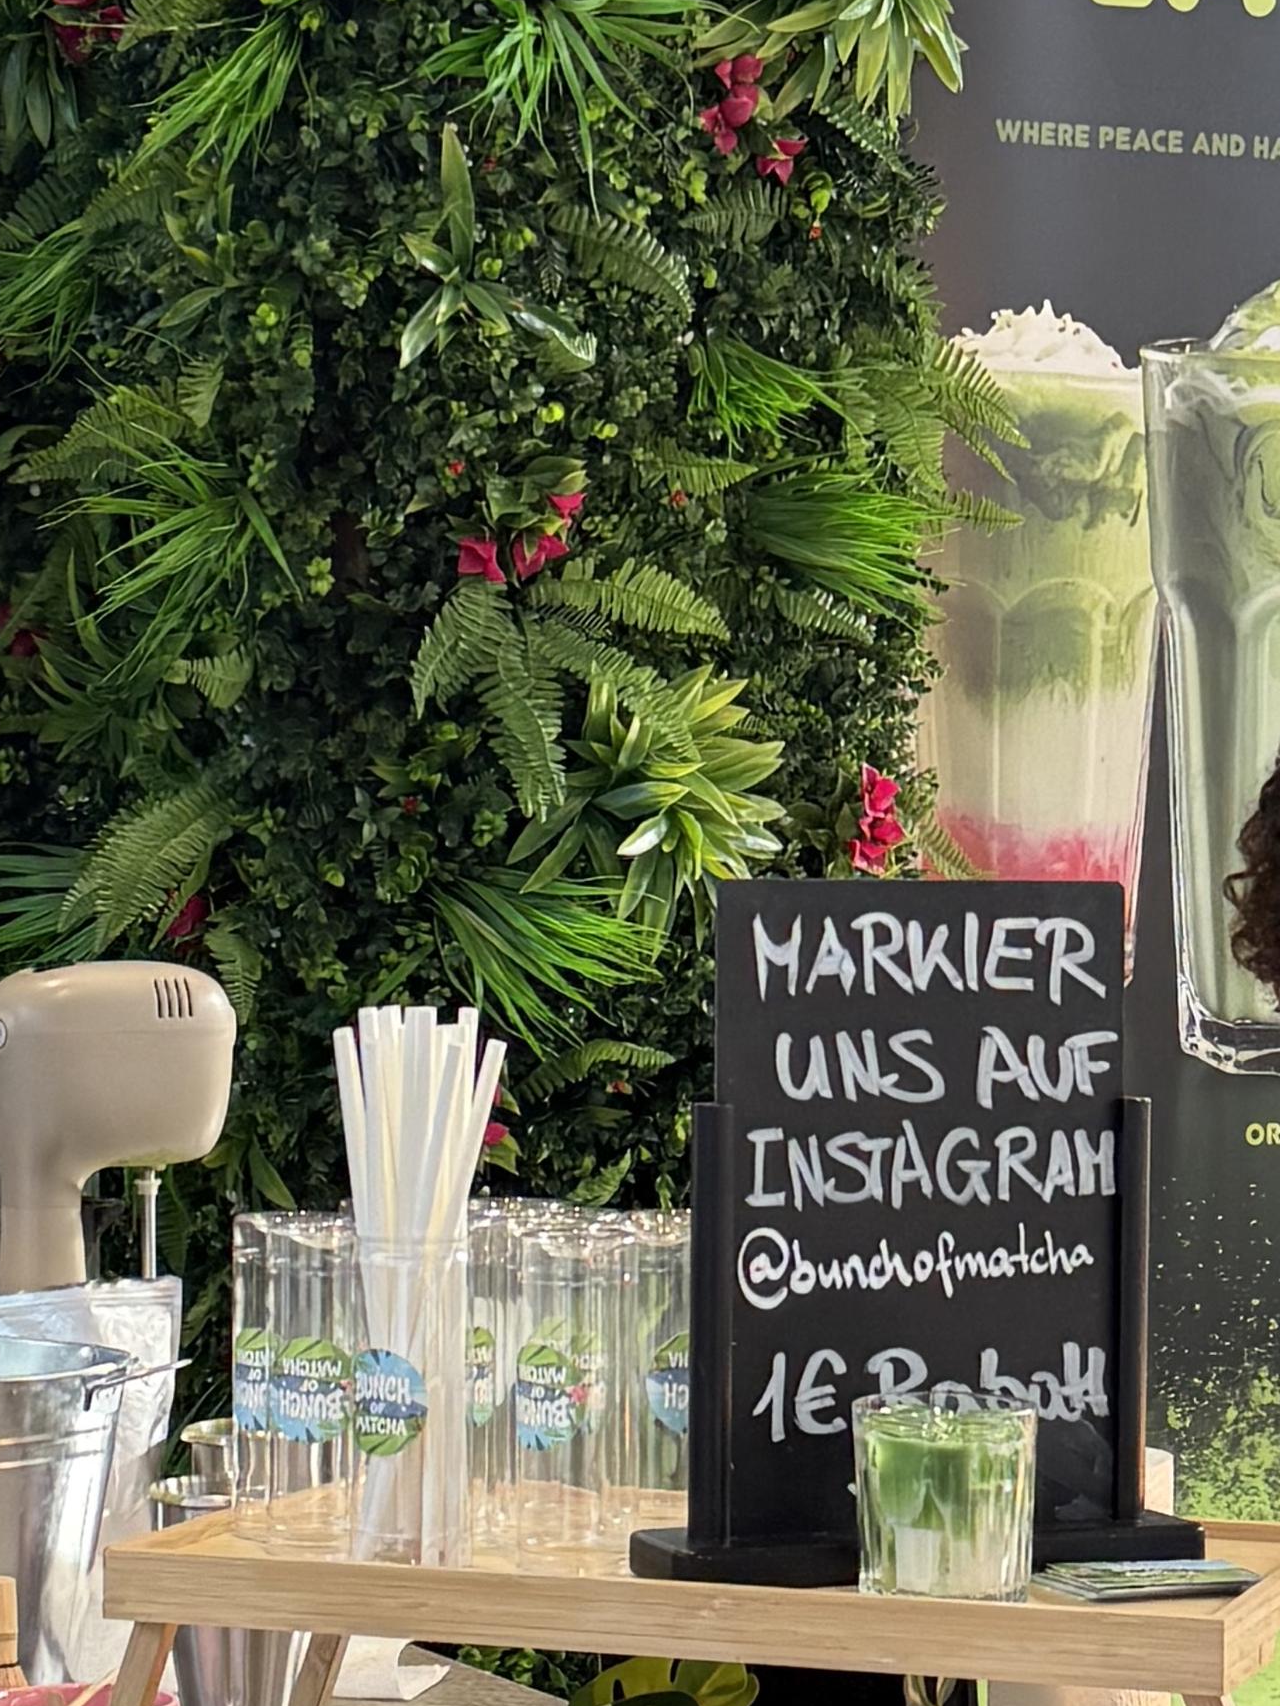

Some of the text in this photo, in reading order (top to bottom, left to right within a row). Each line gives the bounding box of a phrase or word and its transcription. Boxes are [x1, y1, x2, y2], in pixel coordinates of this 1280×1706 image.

[995, 118, 1091, 149] WHERE
[1098, 125, 1184, 154] PEACE
[1192, 131, 1246, 157] AND
[752, 911, 1107, 1005] MARKIER
[774, 1024, 1119, 1110] UNS AUF
[744, 1119, 1116, 1212] INSTAGRAM
[737, 1222, 1095, 1311] @bunchofmatcha
[752, 1348, 848, 1443] 1€
